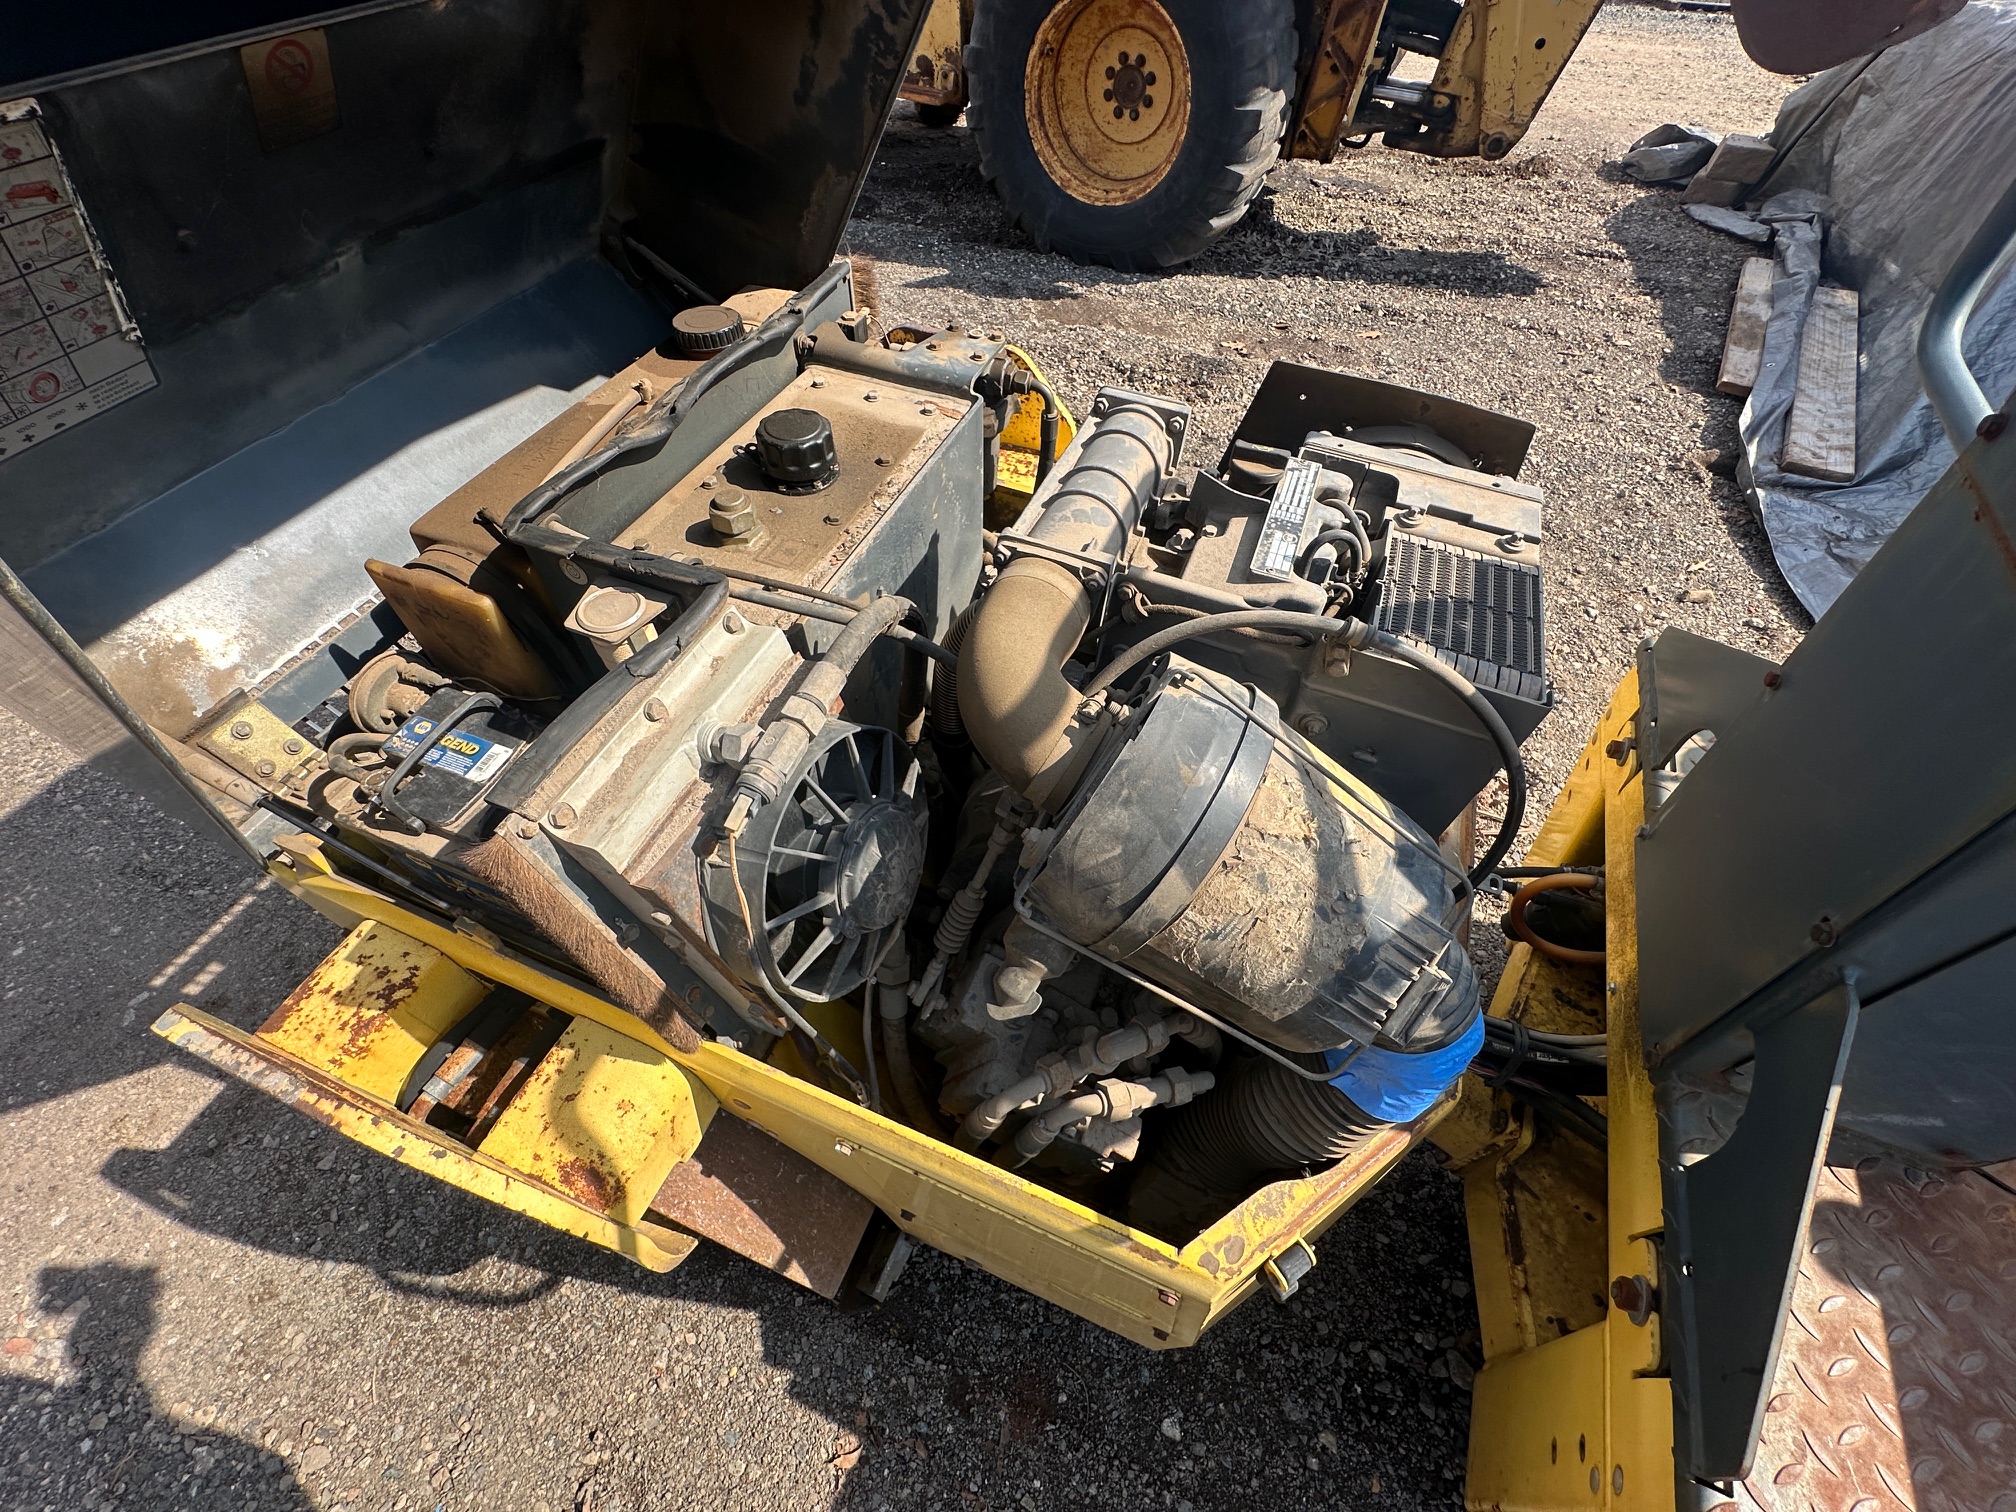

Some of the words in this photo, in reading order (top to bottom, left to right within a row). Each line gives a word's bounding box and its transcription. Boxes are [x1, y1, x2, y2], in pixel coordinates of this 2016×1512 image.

[16, 422, 36, 433] 1000
[46, 408, 66, 420] 2000
[438, 734, 480, 755] GEND
